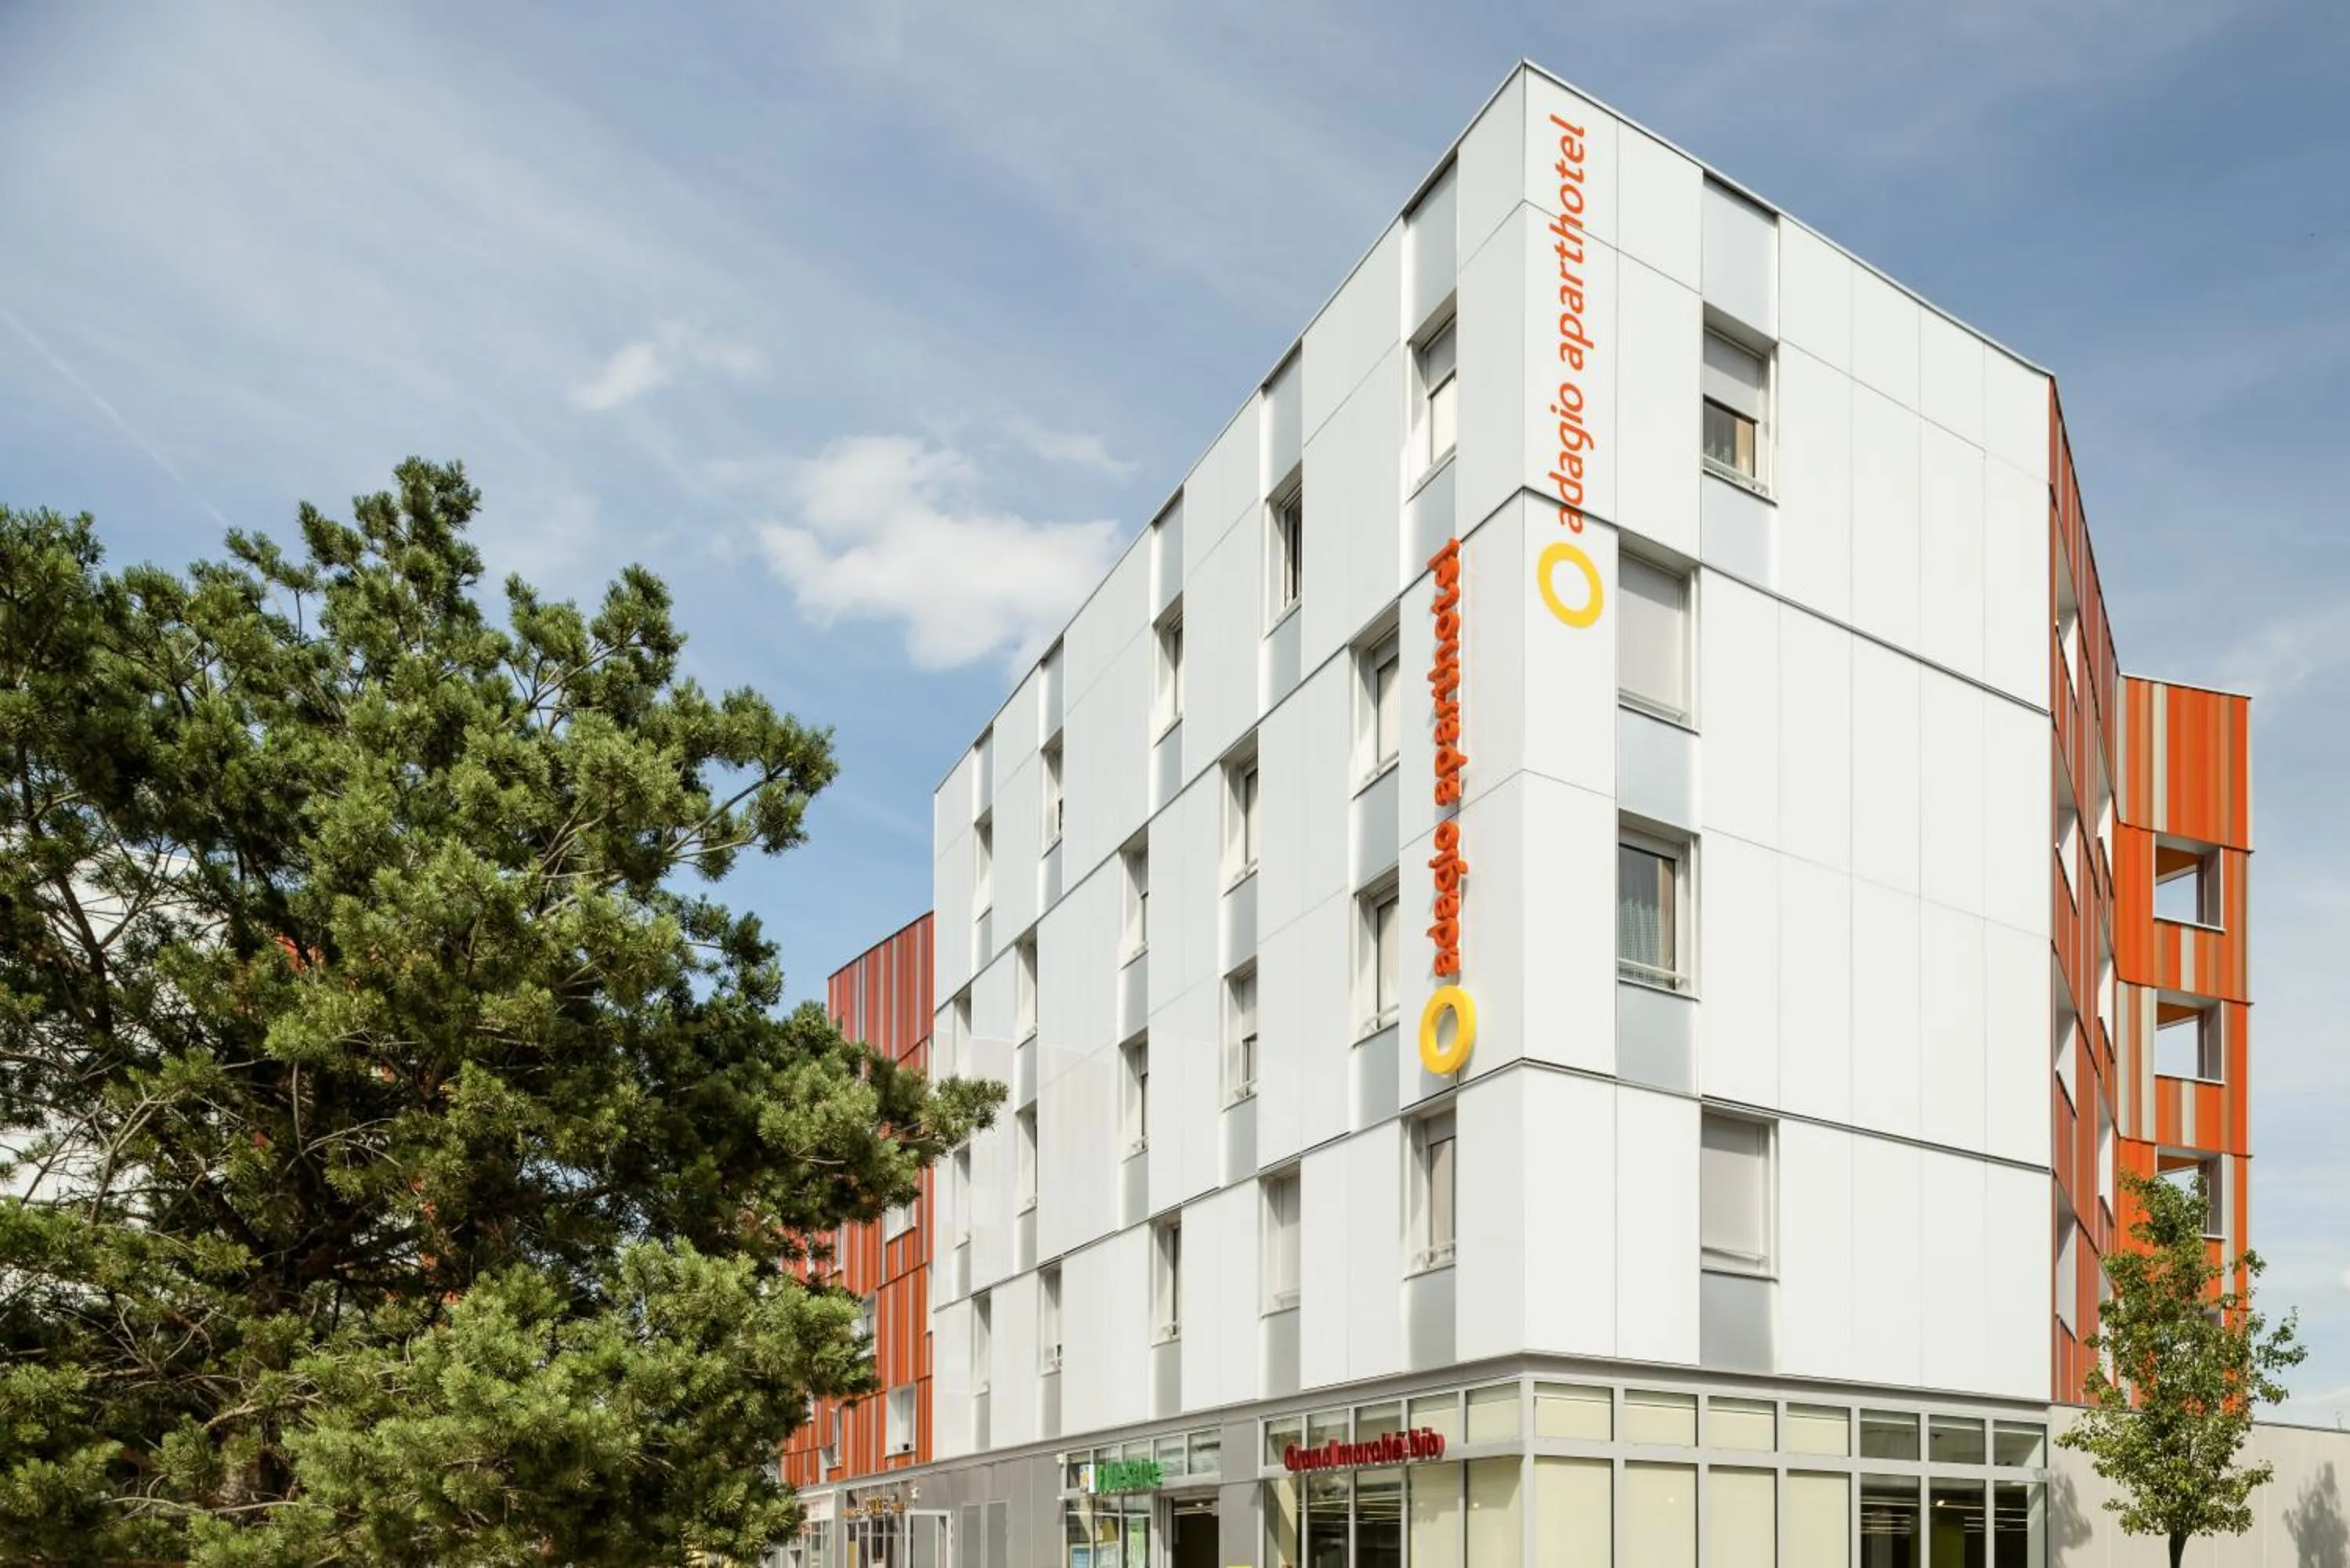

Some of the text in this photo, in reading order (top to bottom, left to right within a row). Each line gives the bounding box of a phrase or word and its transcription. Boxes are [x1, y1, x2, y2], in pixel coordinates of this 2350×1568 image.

[1549, 114, 1594, 534] adagio aparthotel
[1428, 537, 1469, 978] adagio aparthotel
[1284, 1440, 1339, 1471] Grand
